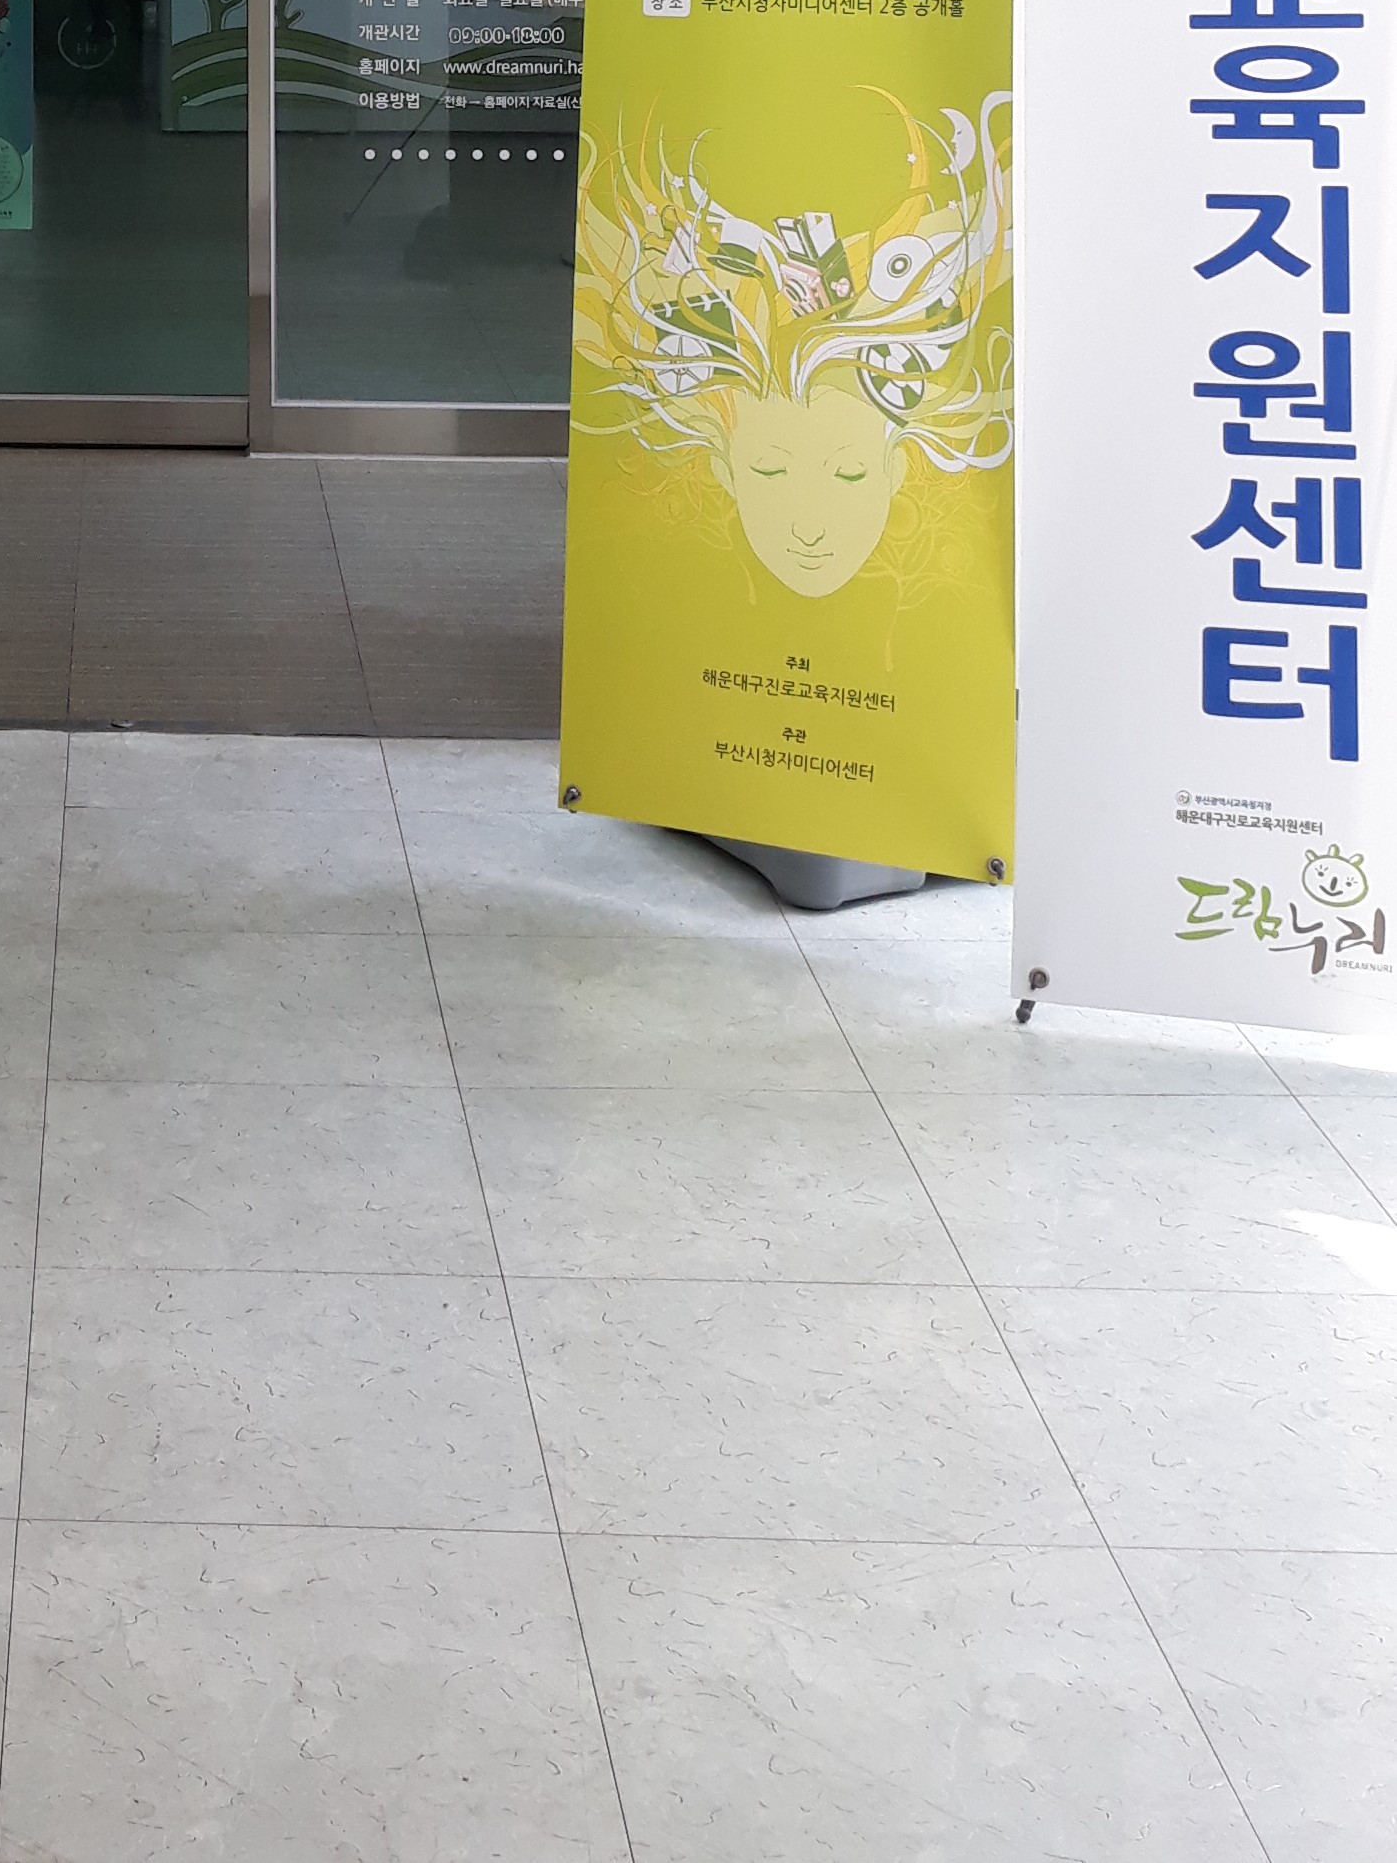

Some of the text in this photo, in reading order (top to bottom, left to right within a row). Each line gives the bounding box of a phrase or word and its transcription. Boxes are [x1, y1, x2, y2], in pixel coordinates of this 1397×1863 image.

[358, 25, 421, 42] 개관시간
[358, 59, 420, 75] 홈페이지
[359, 92, 530, 109] 이용방법 전화 홈페이지
[785, 656, 810, 672] 주최
[702, 668, 896, 713] 해운대구진로교육지원센터
[782, 727, 807, 744] 주관
[714, 740, 875, 783] 부산시청자미디어센터
[1175, 809, 1324, 836] 해운대구진로교육지원센터
[1174, 875, 1386, 975] 드림누리
